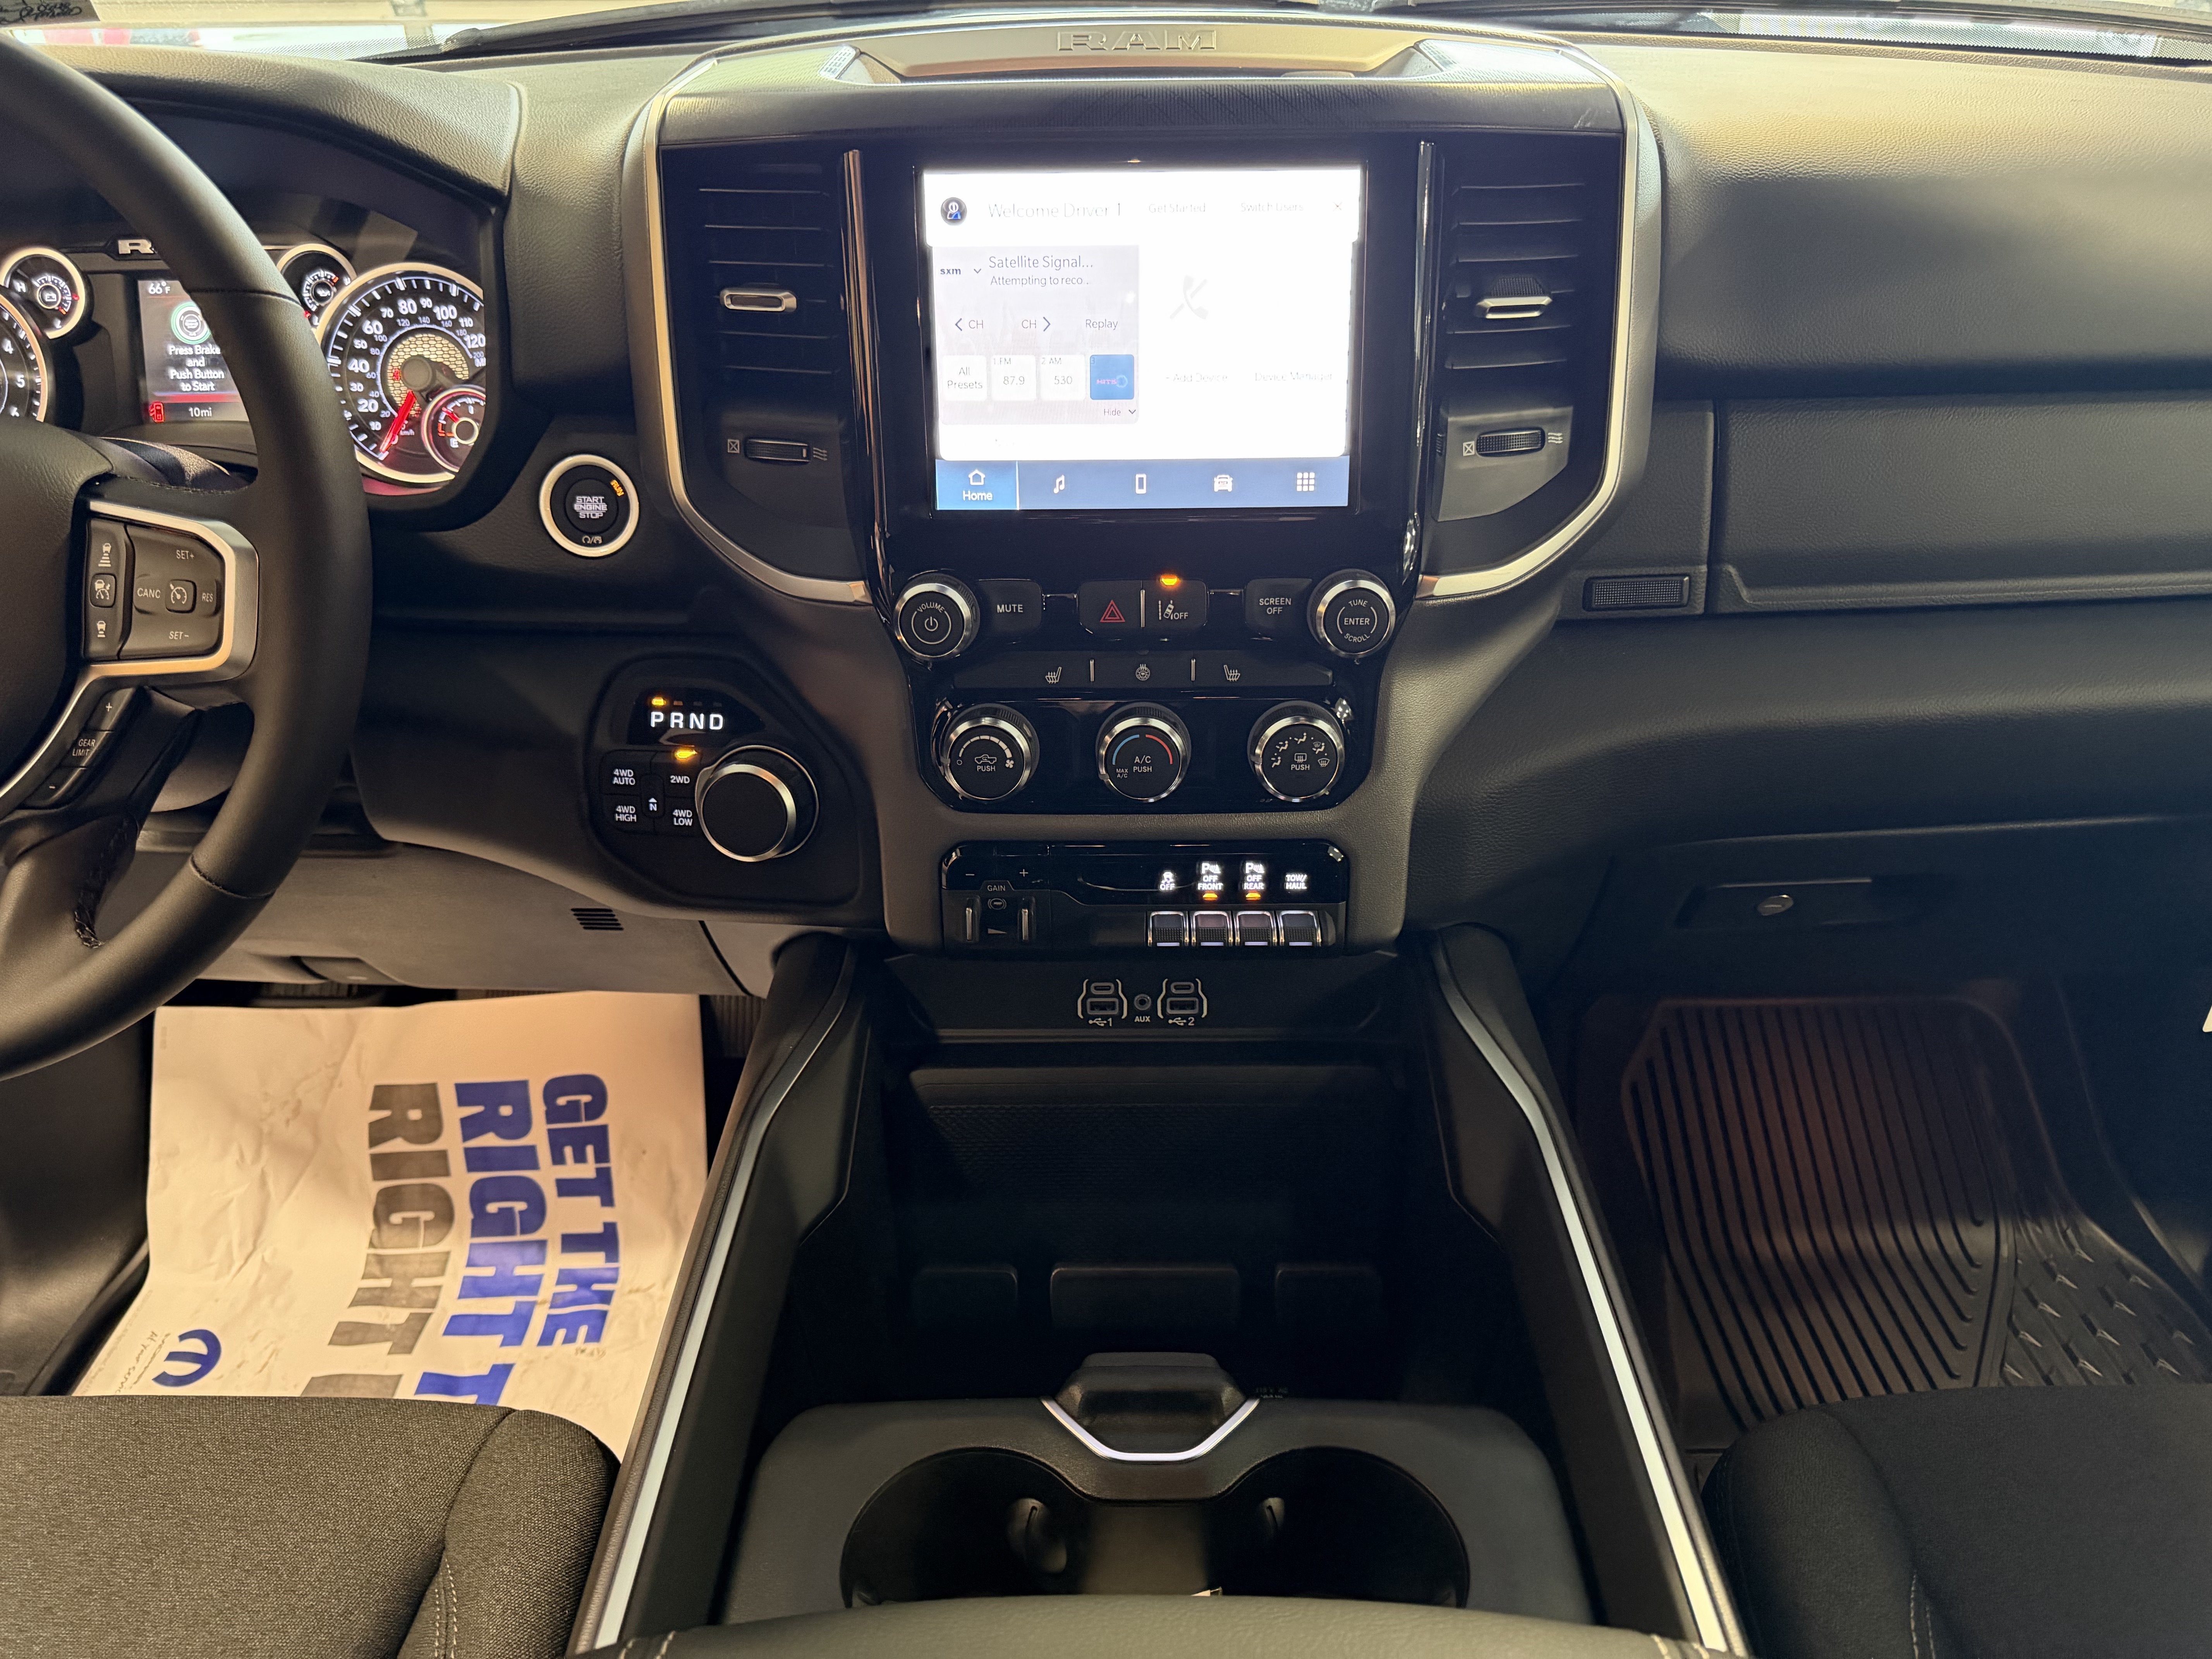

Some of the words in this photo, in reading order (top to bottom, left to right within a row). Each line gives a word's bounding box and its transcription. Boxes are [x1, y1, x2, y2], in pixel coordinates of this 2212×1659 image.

[1057, 29, 1216, 50] RAM
[989, 203, 1059, 218] Welcome
[1064, 202, 1109, 218] Driver
[1117, 203, 1121, 216] 1
[118, 239, 153, 254] R
[989, 256, 1039, 269] Satellite
[990, 275, 1046, 287] Attempting
[1049, 276, 1059, 285] to
[398, 299, 417, 314] 80
[420, 297, 432, 308] 90
[380, 307, 394, 318] 70
[433, 305, 457, 320] 100
[397, 318, 410, 327] 120
[459, 317, 473, 327] 110
[969, 320, 984, 329] CH
[1022, 319, 1037, 329] CH
[1085, 319, 1118, 330] Replay
[362, 320, 383, 335] 60
[353, 339, 367, 349] 50
[465, 333, 486, 348] 120
[2, 339, 13, 354] 4
[169, 345, 193, 355] Press
[194, 344, 221, 354] Brake
[186, 356, 205, 367] and
[349, 359, 370, 373] 40
[170, 368, 192, 379] Push
[194, 368, 225, 379] Button
[959, 367, 970, 376] All
[15, 374, 25, 388] 5
[180, 381, 192, 391] to
[192, 380, 215, 391] Start
[948, 380, 983, 389] Presets
[1003, 376, 1025, 386] 87.9
[1054, 376, 1073, 385] 530
[350, 383, 364, 392] 30
[357, 399, 379, 412] 20
[1104, 409, 1121, 417] Hide
[369, 421, 381, 430] 10
[450, 438, 459, 448] E
[610, 479, 624, 496] RUN
[962, 490, 993, 501] Home
[137, 587, 161, 598] CANC
[202, 593, 213, 603] RES
[1259, 598, 1291, 606] SCREEN
[917, 602, 945, 614] VOLUME
[997, 604, 1024, 613] MUTE
[1348, 599, 1368, 608] TUNE
[1344, 618, 1370, 626] ENTER
[1344, 633, 1370, 643] SCROLL
[78, 738, 96, 747] GEAR
[1134, 755, 1151, 764] A/C
[613, 769, 634, 777] 4WD
[613, 777, 635, 786] AUTO
[670, 775, 690, 784] 2WD
[616, 805, 635, 814] 4WD
[649, 802, 657, 811] N
[615, 814, 637, 822] HIGH
[673, 809, 692, 818] 4WD
[673, 817, 693, 826] LOW
[1285, 874, 1307, 883] TOW/
[1107, 1017, 1112, 1027] 1
[1188, 1017, 1195, 1026] 2
[543, 1074, 616, 1207] GET
[328, 1082, 455, 1355] RIGHT
[442, 1080, 547, 1348] RIGHT
